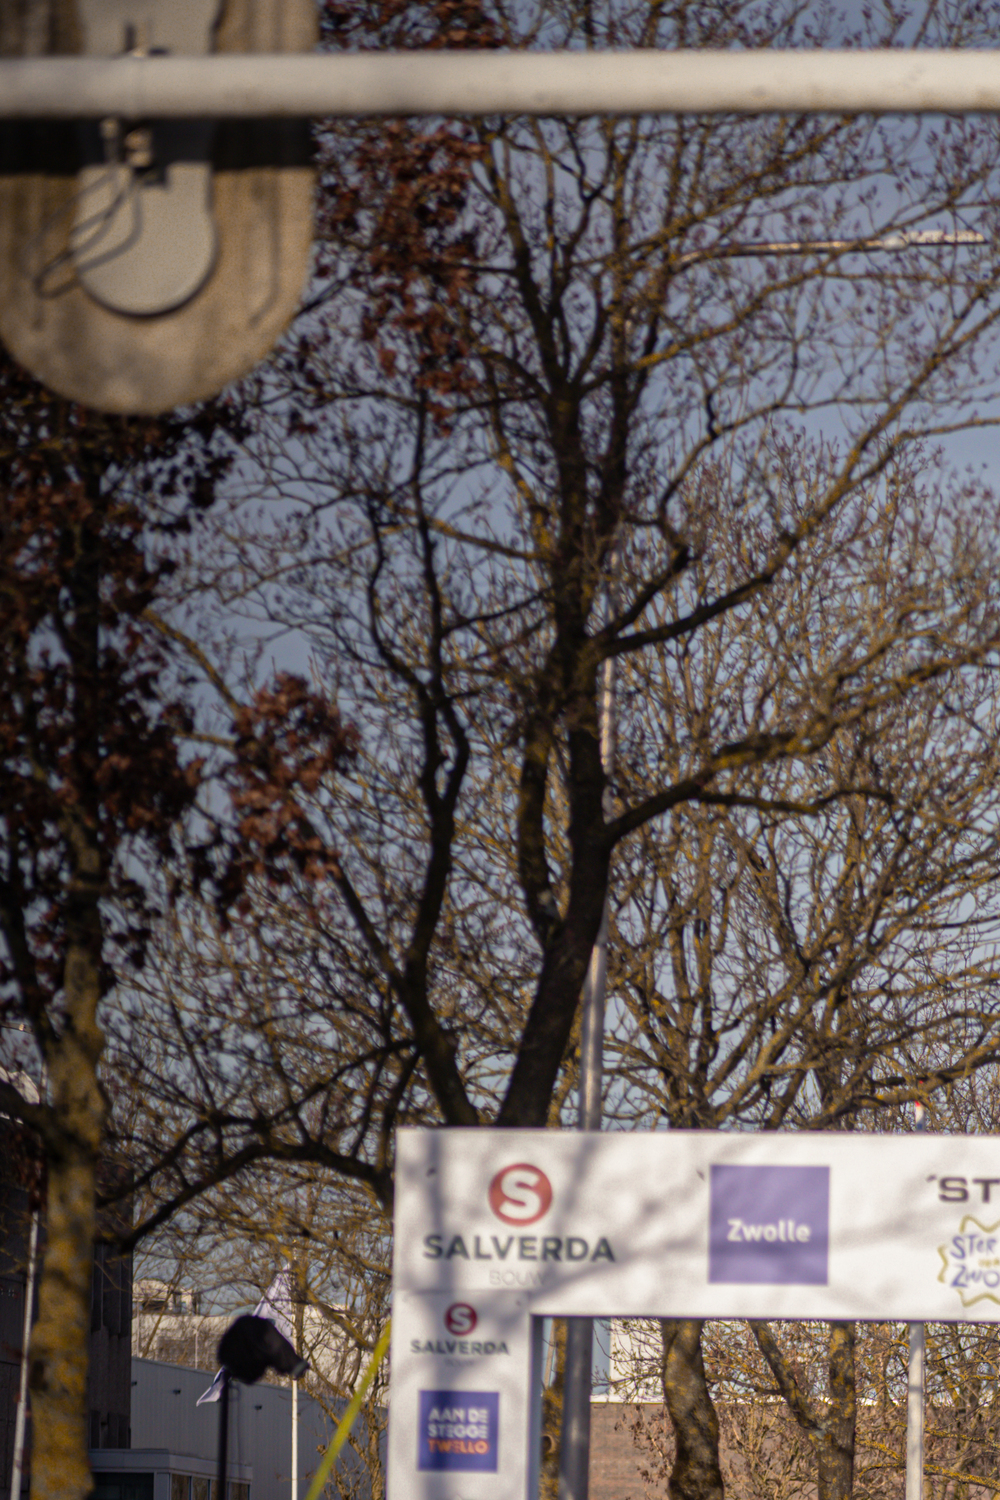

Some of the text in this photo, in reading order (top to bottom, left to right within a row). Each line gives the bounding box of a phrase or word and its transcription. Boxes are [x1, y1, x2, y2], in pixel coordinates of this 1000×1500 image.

[727, 1219, 811, 1242] Zwolle
[423, 1234, 616, 1262] SALVERDA
[410, 1339, 509, 1356] SALVERDA
[428, 1408, 488, 1423] AAN DE
[428, 1440, 489, 1454] TWELLO
